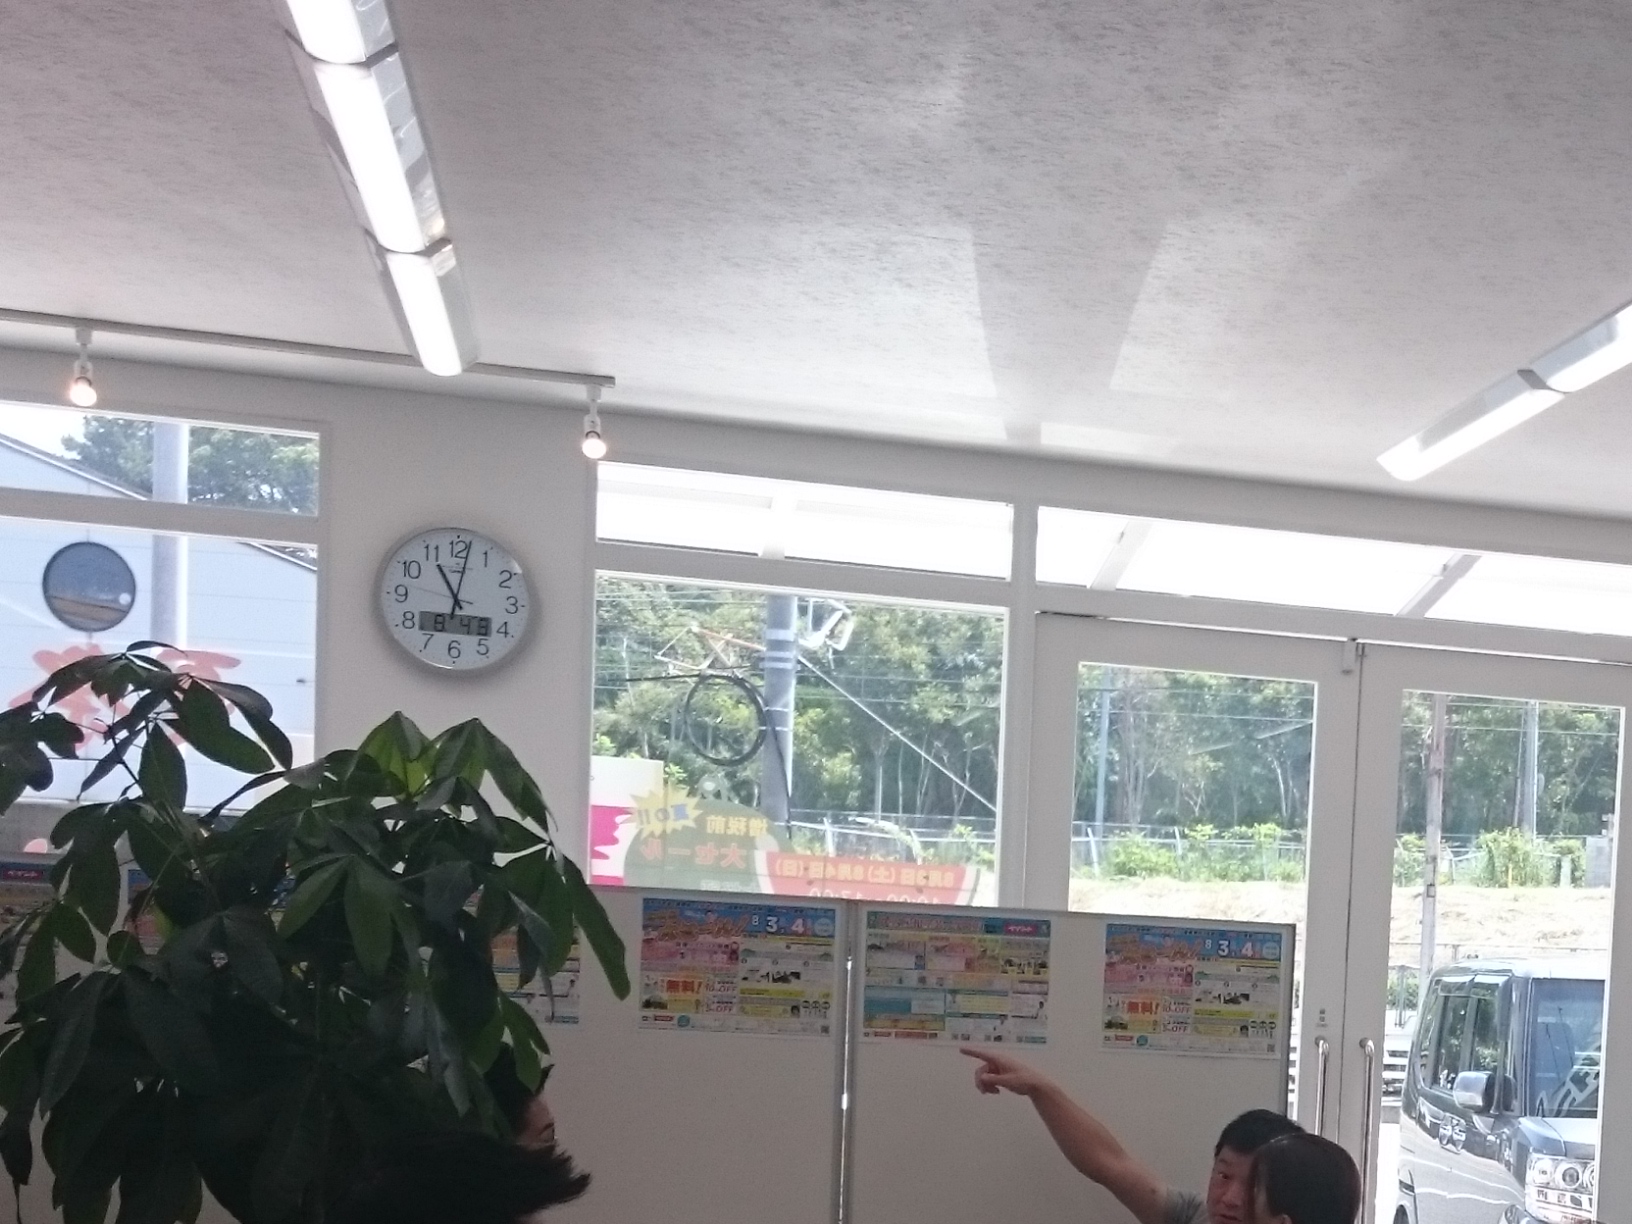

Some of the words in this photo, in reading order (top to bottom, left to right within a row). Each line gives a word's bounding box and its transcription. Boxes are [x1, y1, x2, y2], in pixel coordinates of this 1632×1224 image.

[424, 544, 439, 562] 11
[449, 540, 468, 559] 12
[483, 550, 488, 567] 1
[402, 560, 421, 579] 10
[499, 570, 512, 589] 2
[394, 584, 408, 603] 9
[505, 596, 519, 614] 3
[402, 611, 415, 629] 8
[496, 621, 509, 638] 4
[422, 633, 434, 650] 7
[447, 640, 461, 659] 6
[476, 638, 489, 656] 5
[766, 916, 778, 933] 3
[1218, 940, 1230, 956] 3
